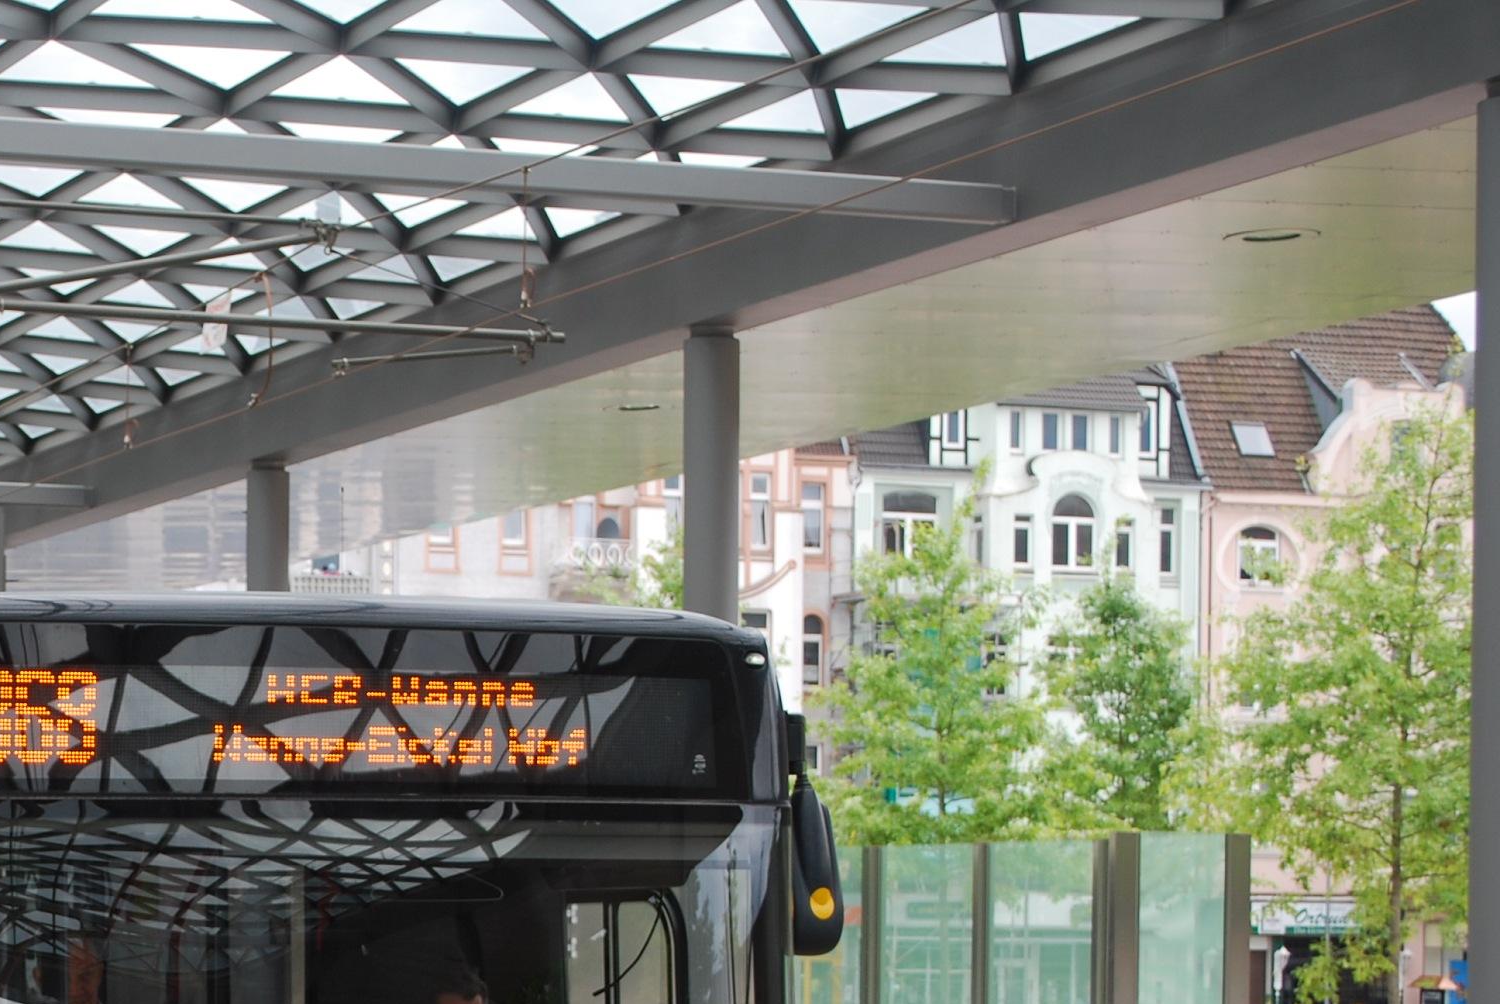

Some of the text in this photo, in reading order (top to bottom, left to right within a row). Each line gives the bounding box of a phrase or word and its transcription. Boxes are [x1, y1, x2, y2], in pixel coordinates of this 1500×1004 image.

[267, 673, 535, 707] HCR-Wanne
[214, 723, 586, 766] Wanne-Eickel Hbf
